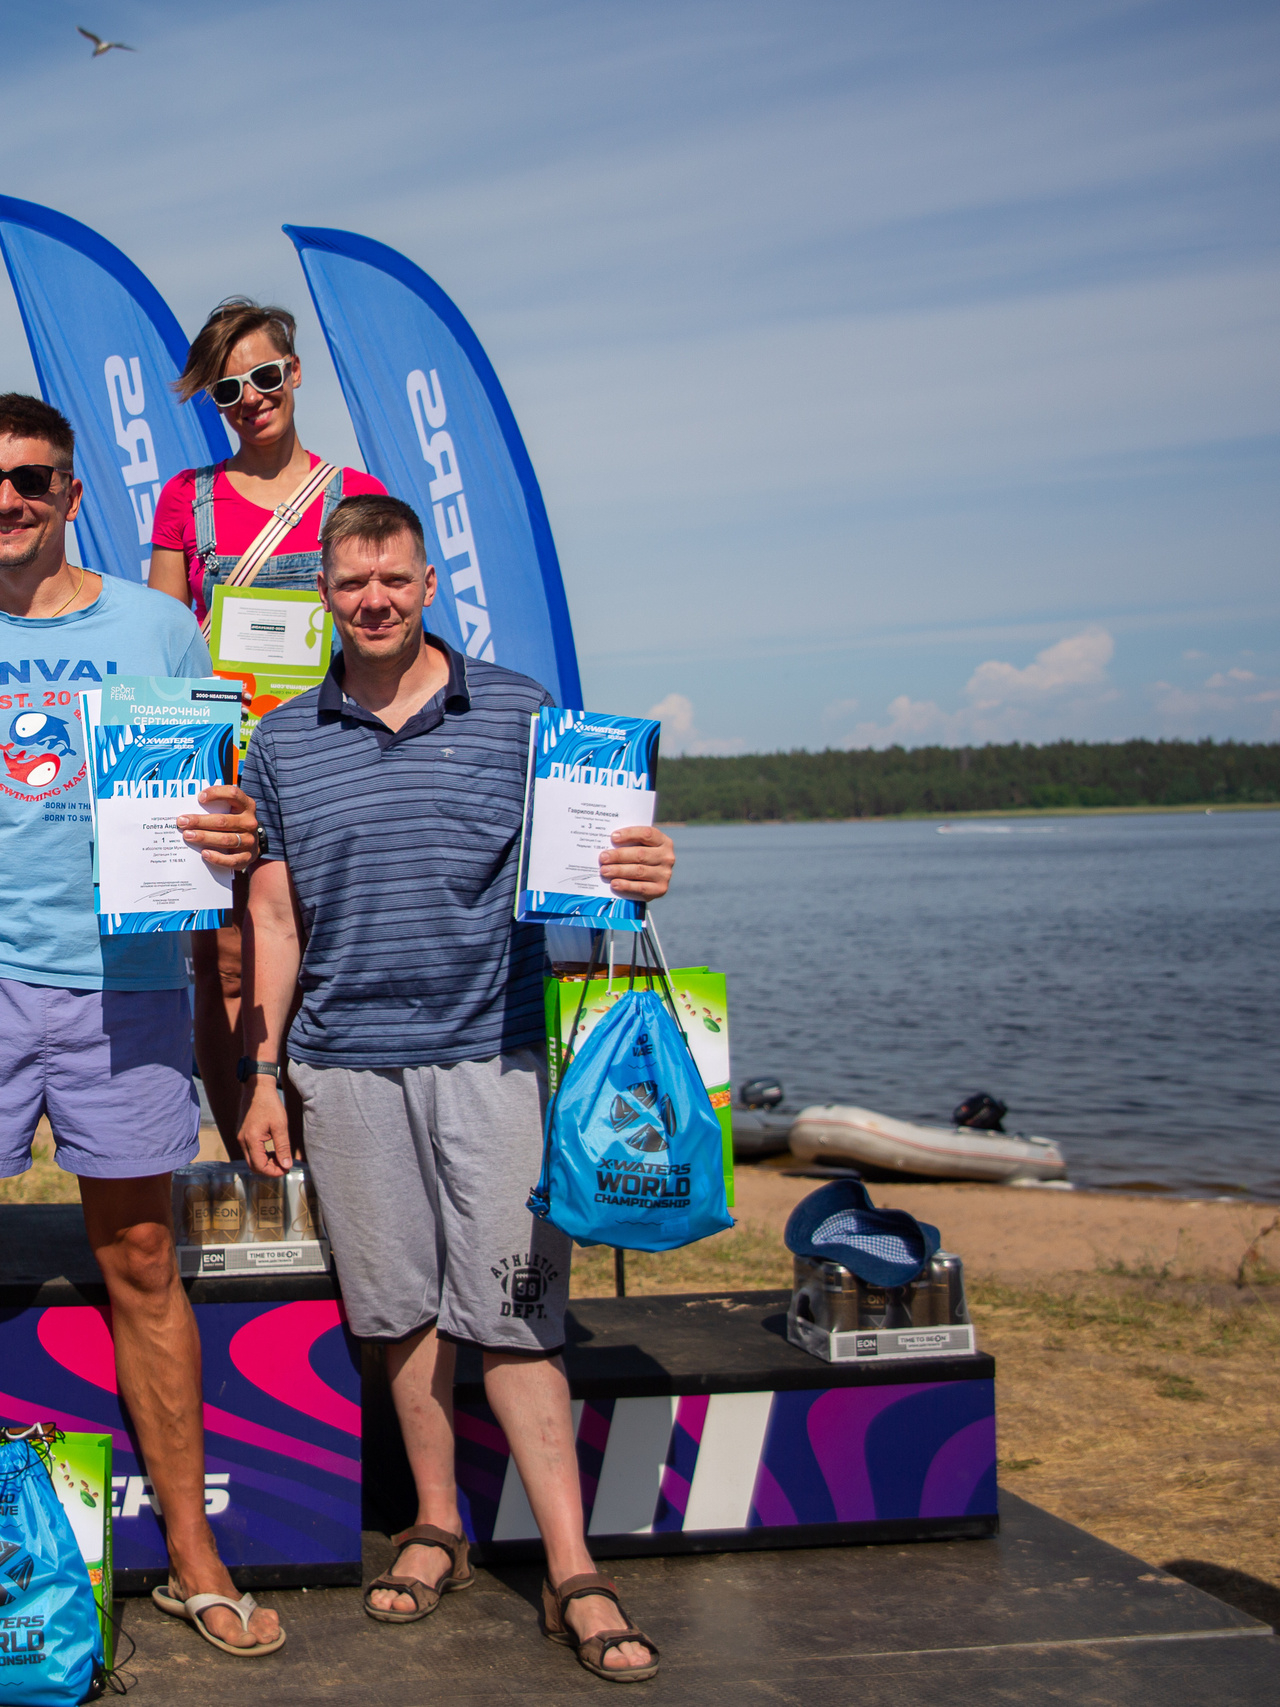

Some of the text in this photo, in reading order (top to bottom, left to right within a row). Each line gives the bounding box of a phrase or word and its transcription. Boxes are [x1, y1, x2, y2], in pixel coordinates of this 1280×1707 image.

[110, 683, 136, 694] SPORT
[110, 693, 136, 701] FERMA
[129, 704, 211, 717] ПОДАРОЧНЫЙ
[546, 762, 648, 791] ДИПЛОМ
[595, 1170, 691, 1198] WORLD
[593, 1192, 691, 1209] CHAMPIONSHIP
[490, 1252, 559, 1281] ATHLETIC
[499, 1301, 547, 1319] DEPT.
